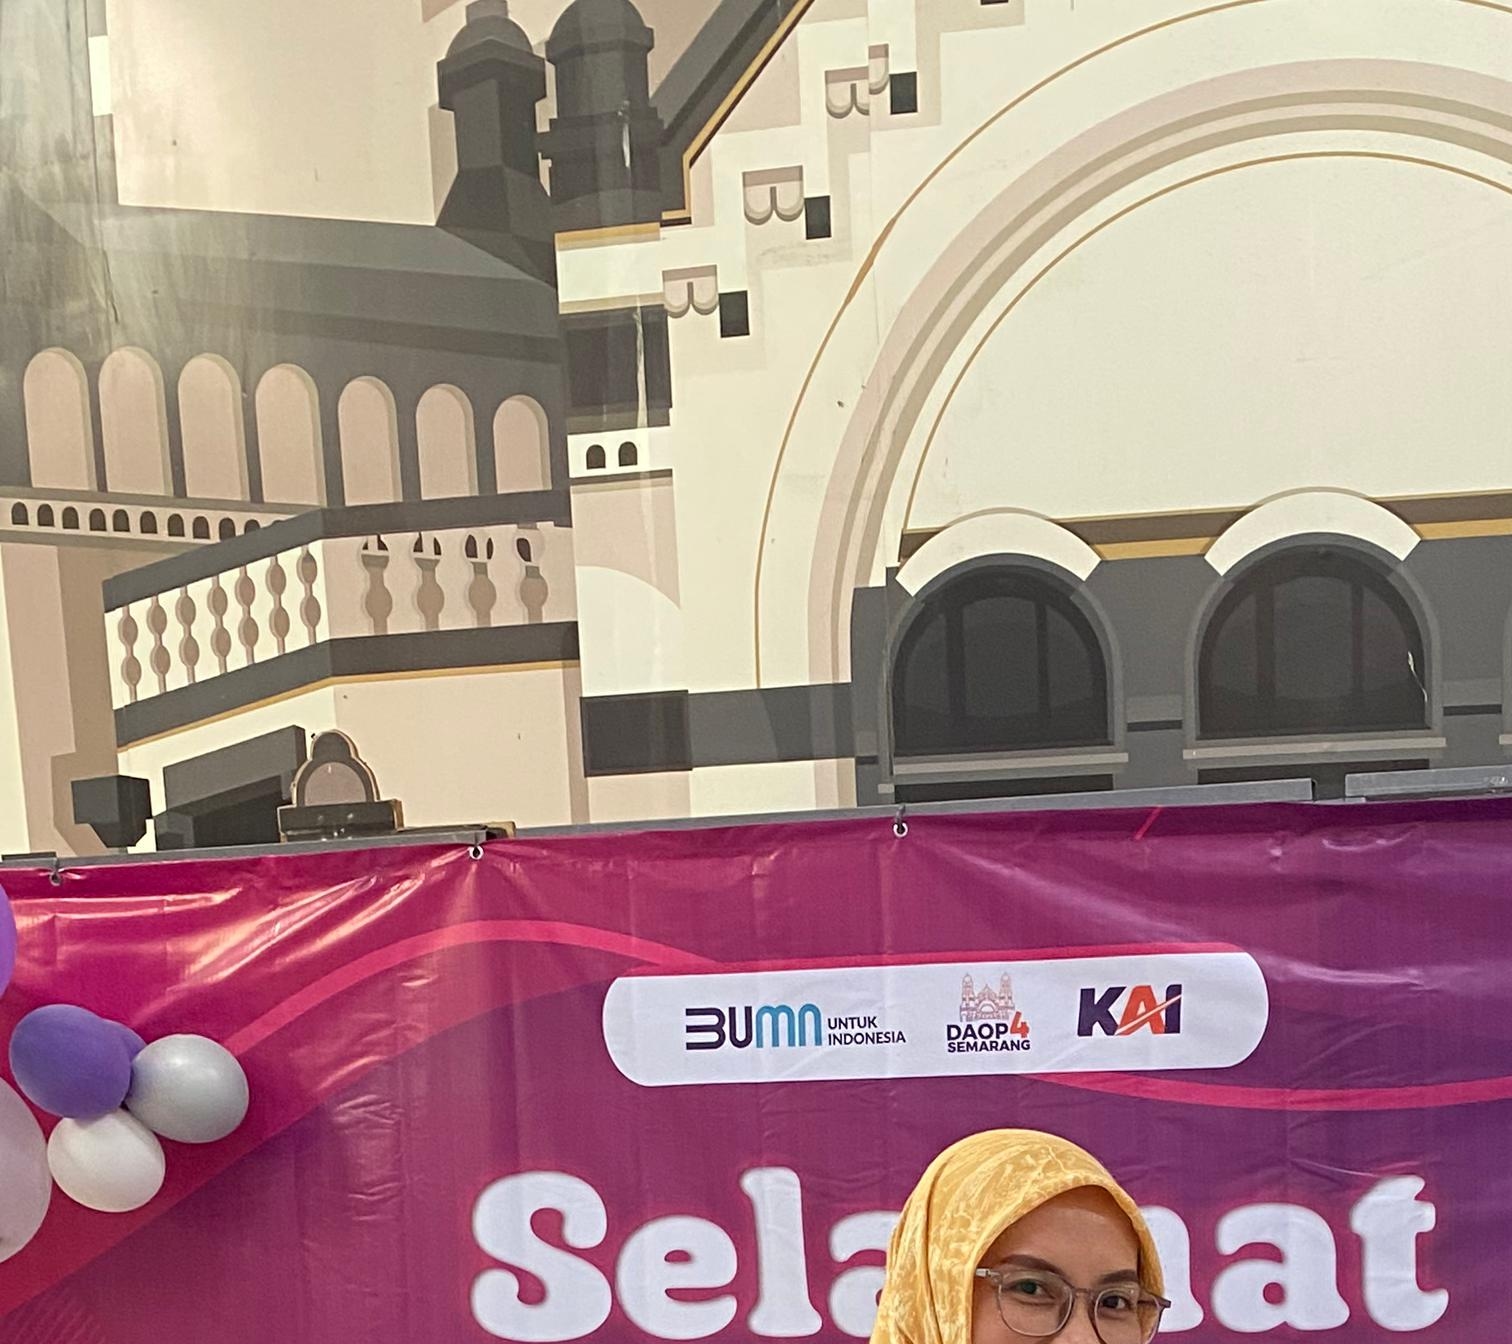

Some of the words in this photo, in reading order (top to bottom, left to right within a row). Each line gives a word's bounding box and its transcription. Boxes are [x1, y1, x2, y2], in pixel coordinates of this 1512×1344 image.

[1076, 983, 1183, 1037] KAI
[827, 1016, 878, 1029] UNTUK
[827, 1030, 907, 1046] INDONESIA
[946, 1038, 1032, 1053] SEMARANG
